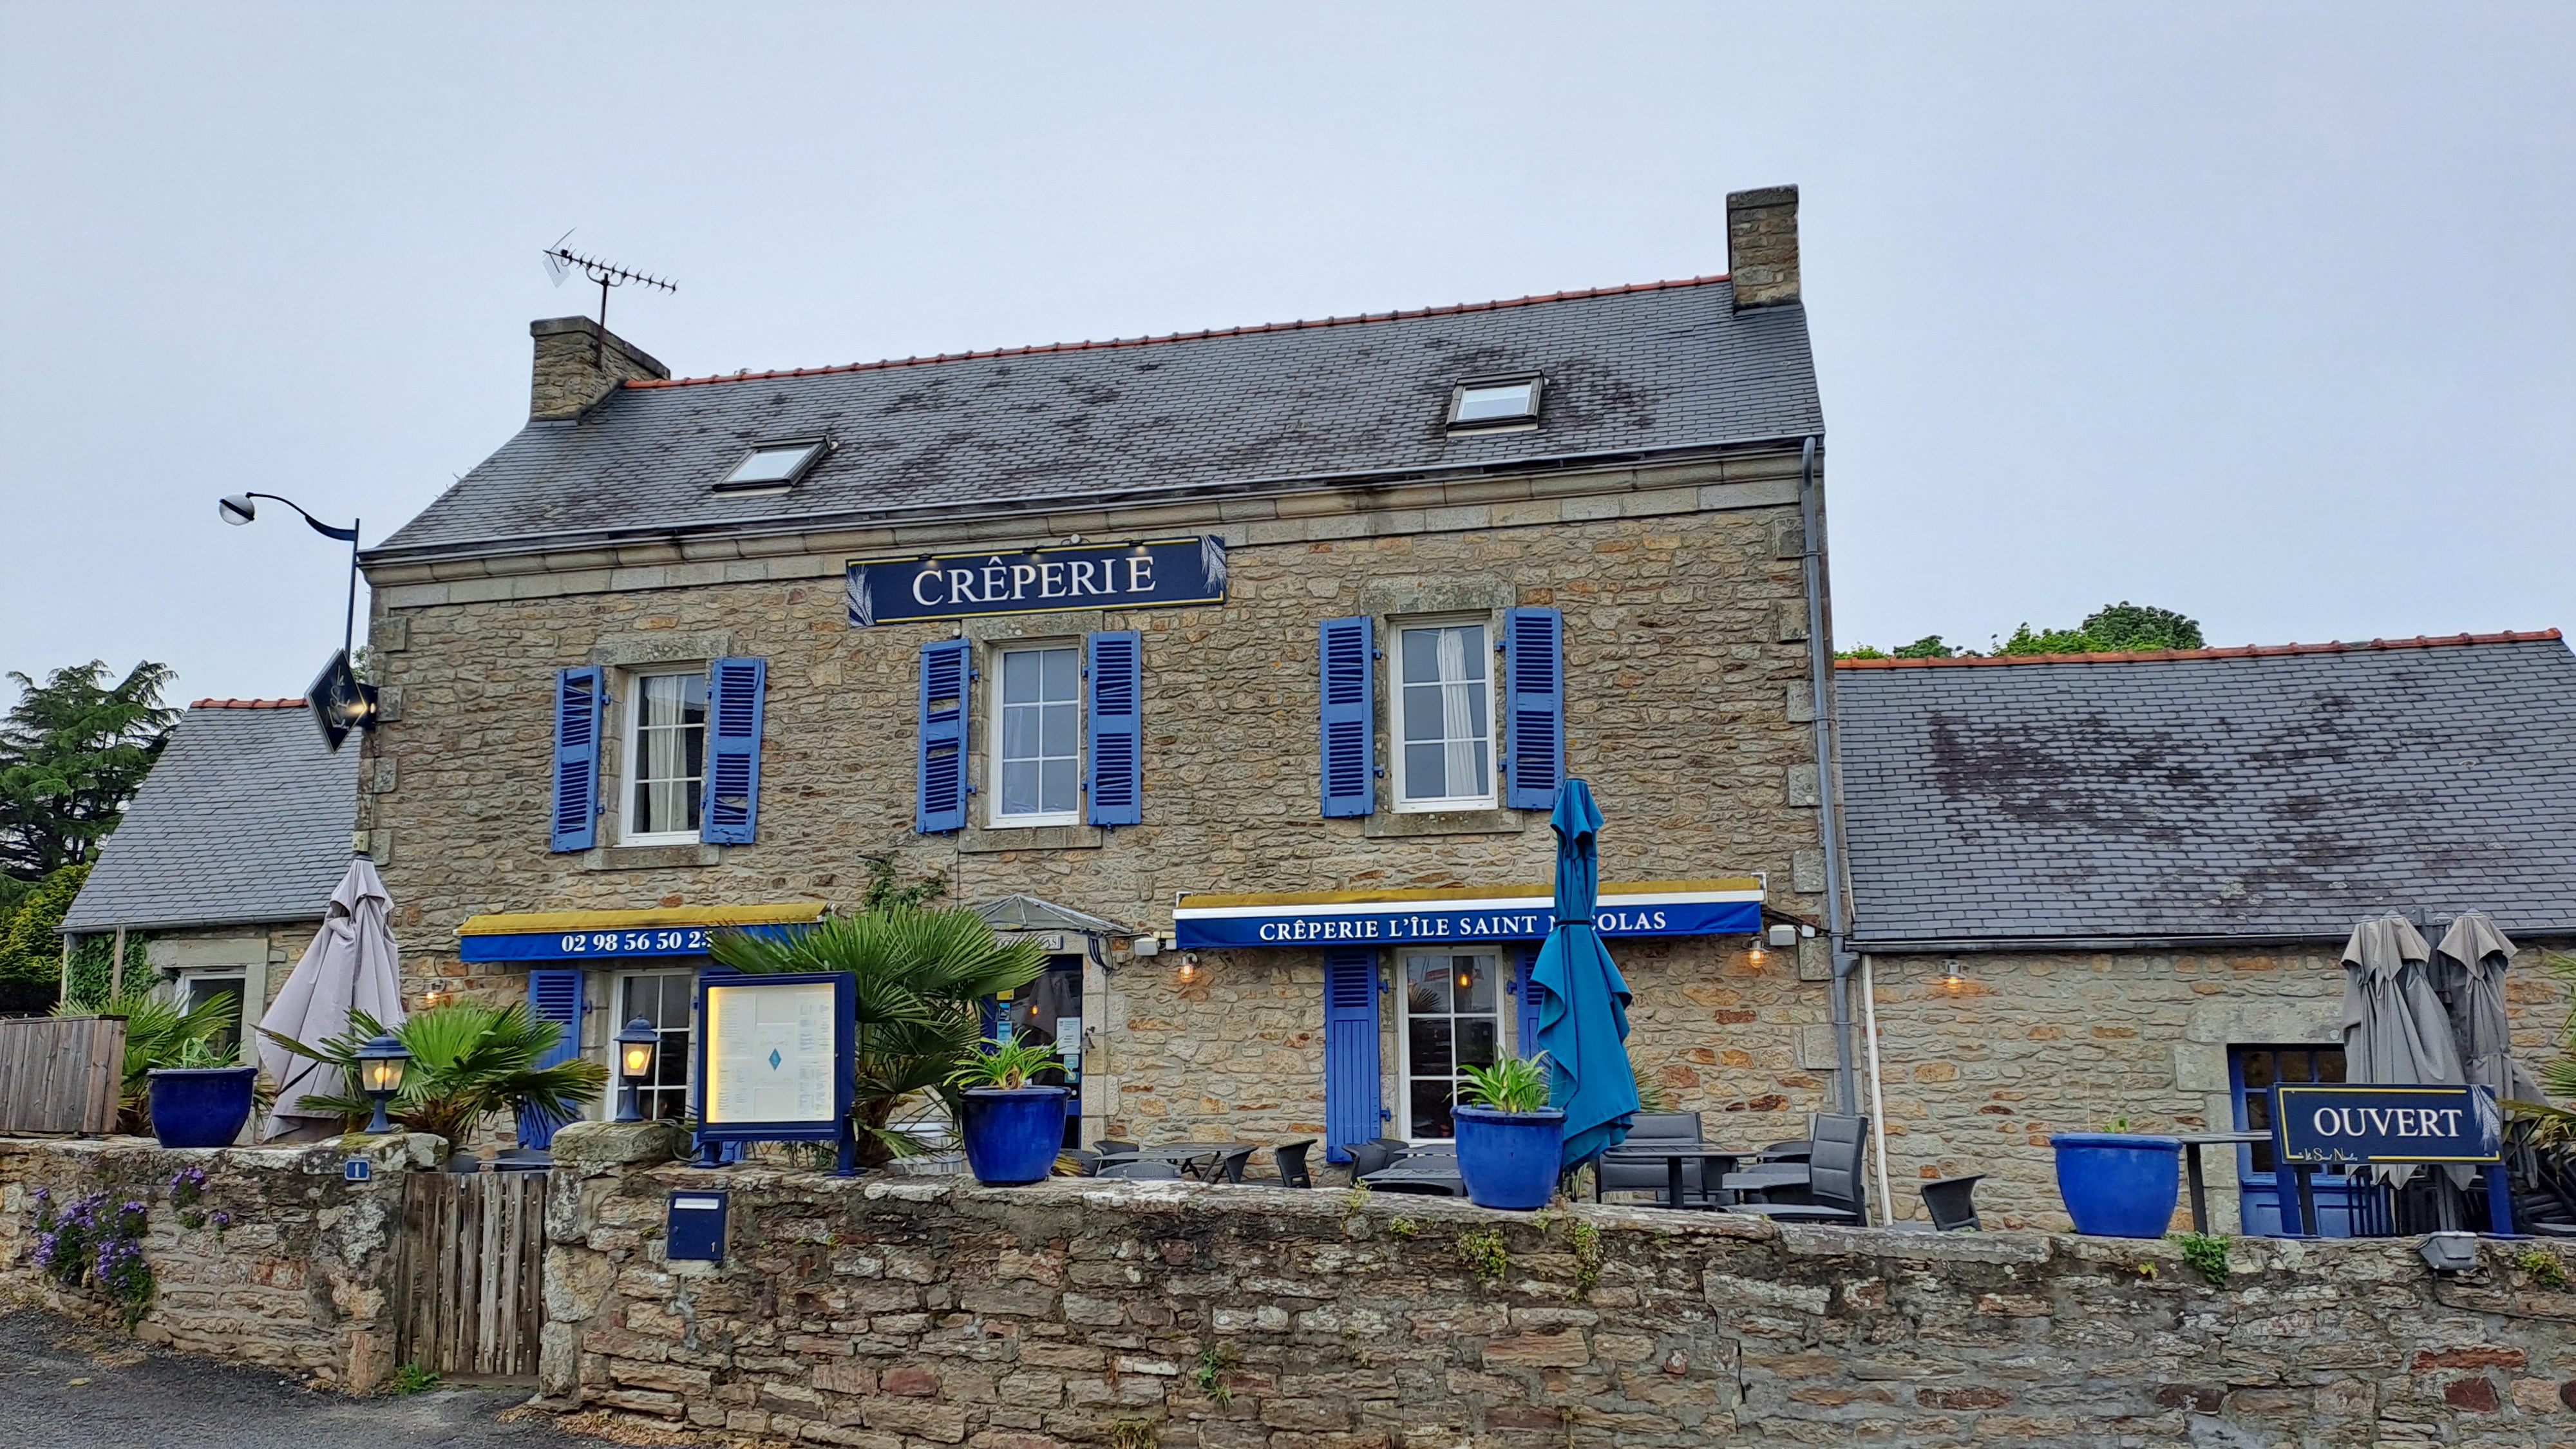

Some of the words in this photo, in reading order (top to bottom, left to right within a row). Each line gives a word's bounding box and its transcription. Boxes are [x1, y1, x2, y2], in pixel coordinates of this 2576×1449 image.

[912, 556, 1157, 606] CRÊPERIE
[1260, 919, 1379, 941] CRÊPERIE
[1459, 915, 1538, 935] SAINT
[1548, 911, 1667, 933] OLAS
[561, 934, 586, 952] 02
[592, 934, 618, 951] 98
[623, 933, 650, 951] 56
[656, 932, 683, 950] 50
[2313, 1107, 2463, 1138] OUVERT
[354, 1163, 360, 1177] 1
[711, 1241, 716, 1253] 1
